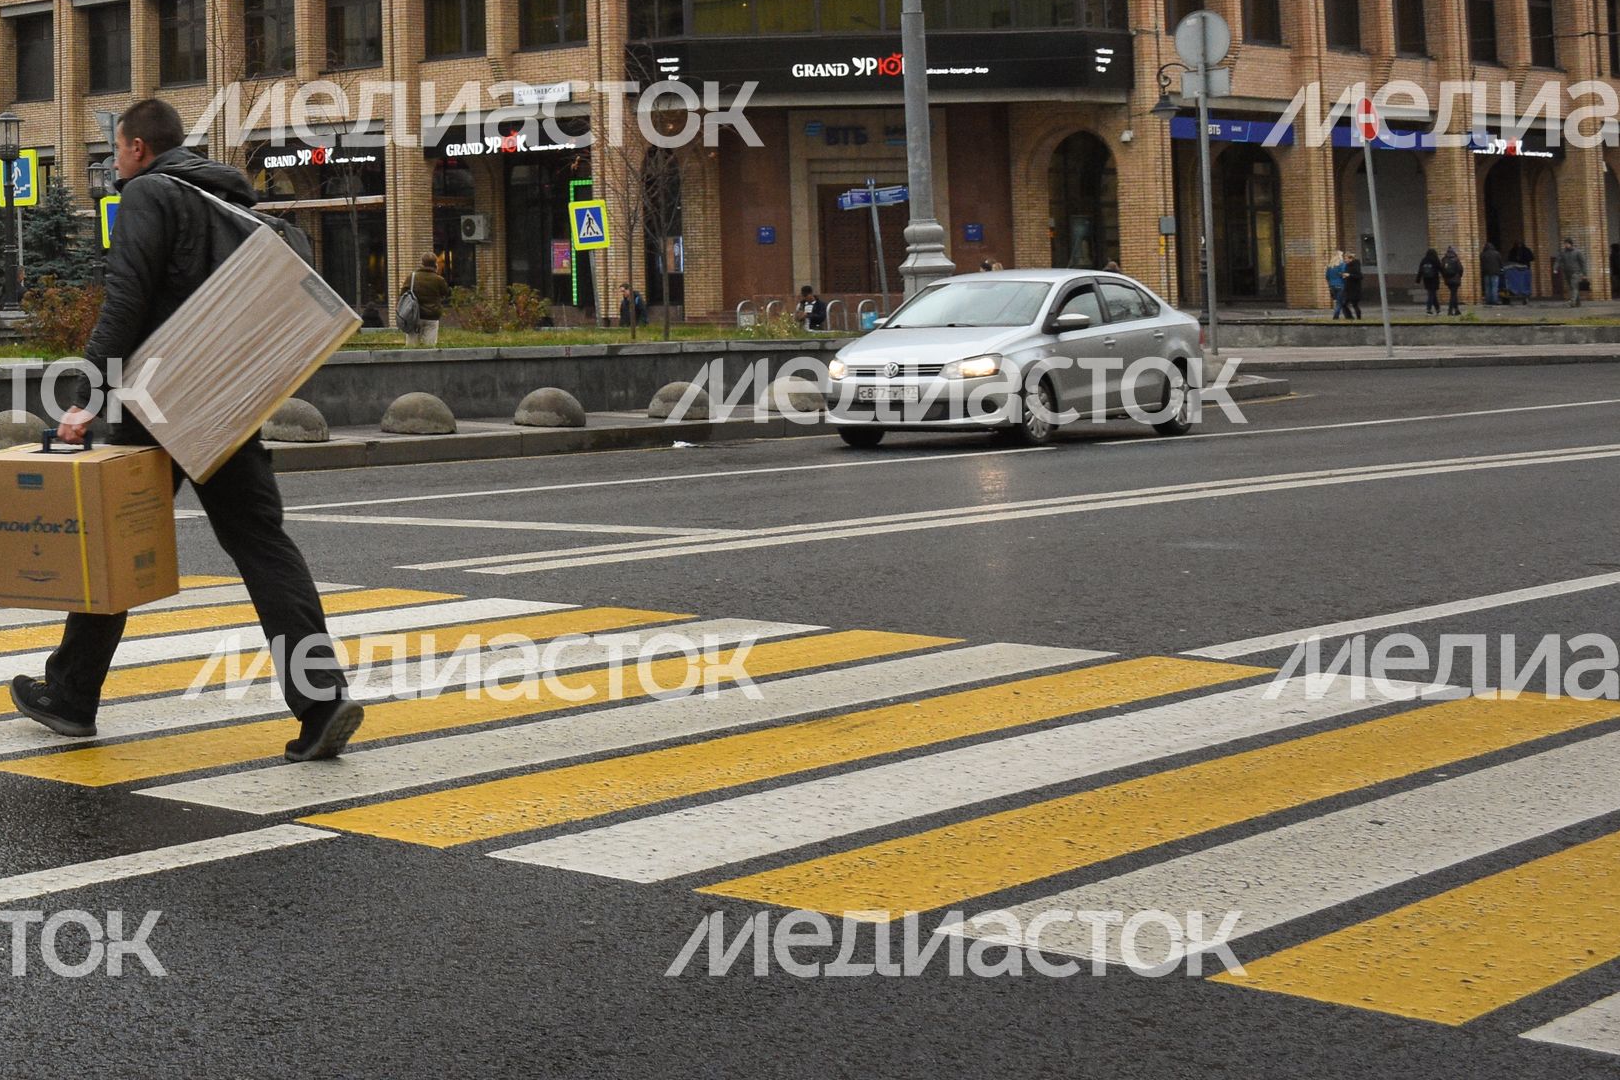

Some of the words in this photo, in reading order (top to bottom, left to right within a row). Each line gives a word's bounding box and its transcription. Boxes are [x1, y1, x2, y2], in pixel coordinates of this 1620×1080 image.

[791, 63, 850, 77] GRAND
[852, 52, 906, 77] УРЮ
[446, 142, 484, 157] GRAND
[264, 154, 296, 169] GRAND
